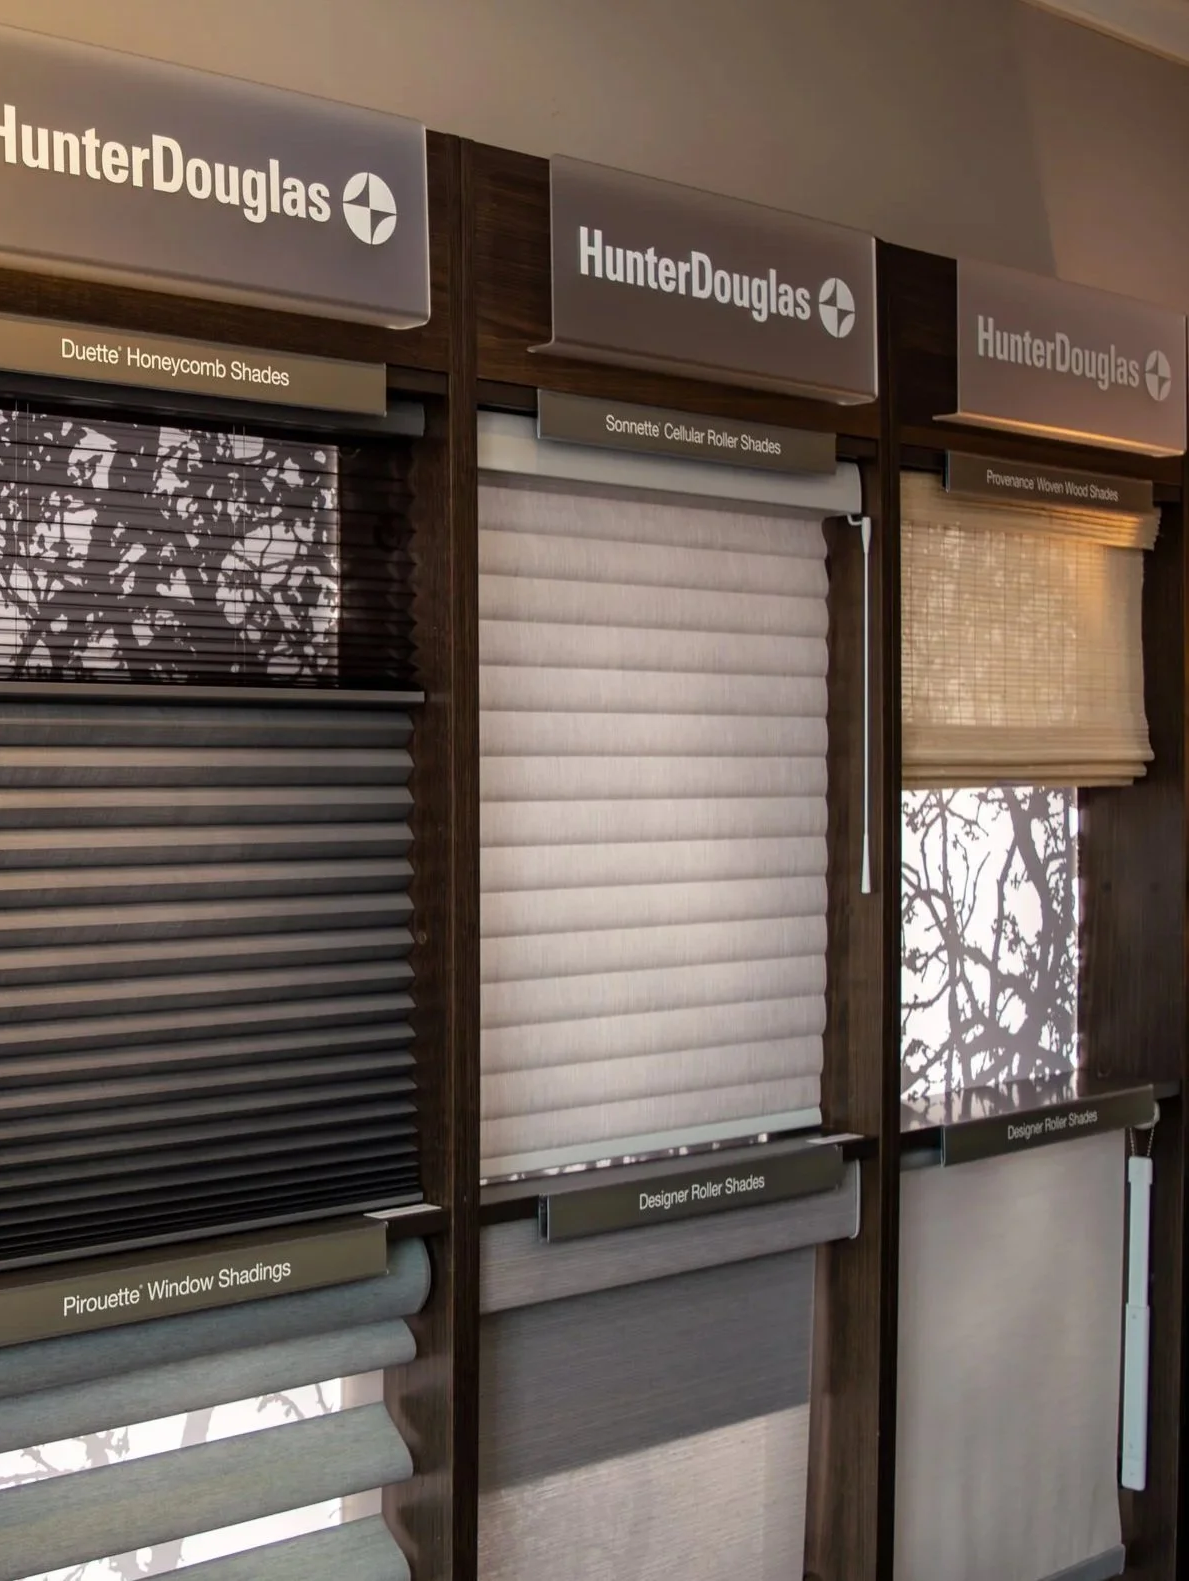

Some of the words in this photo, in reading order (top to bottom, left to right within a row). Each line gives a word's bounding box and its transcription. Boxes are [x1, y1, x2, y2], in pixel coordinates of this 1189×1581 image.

[580, 226, 810, 322] HunterDouglas
[128, 347, 226, 378] Honeycomb
[231, 361, 289, 386] Shades
[978, 315, 1139, 390] HunterDouglas
[664, 423, 705, 443] Cellular
[708, 430, 738, 448] Roller
[741, 434, 781, 454] Shades
[1037, 477, 1063, 493] Woven
[1065, 482, 1088, 497] Wood
[1090, 485, 1118, 501] Shades
[1008, 1122, 1043, 1139] Designer
[1045, 1116, 1067, 1131] Roller
[1069, 1111, 1097, 1126] Shades
[640, 1190, 688, 1210] Designer
[692, 1182, 722, 1200] Roller
[725, 1175, 764, 1194] Shades
[148, 1276, 214, 1300] Window
[219, 1263, 291, 1287] Shadings
